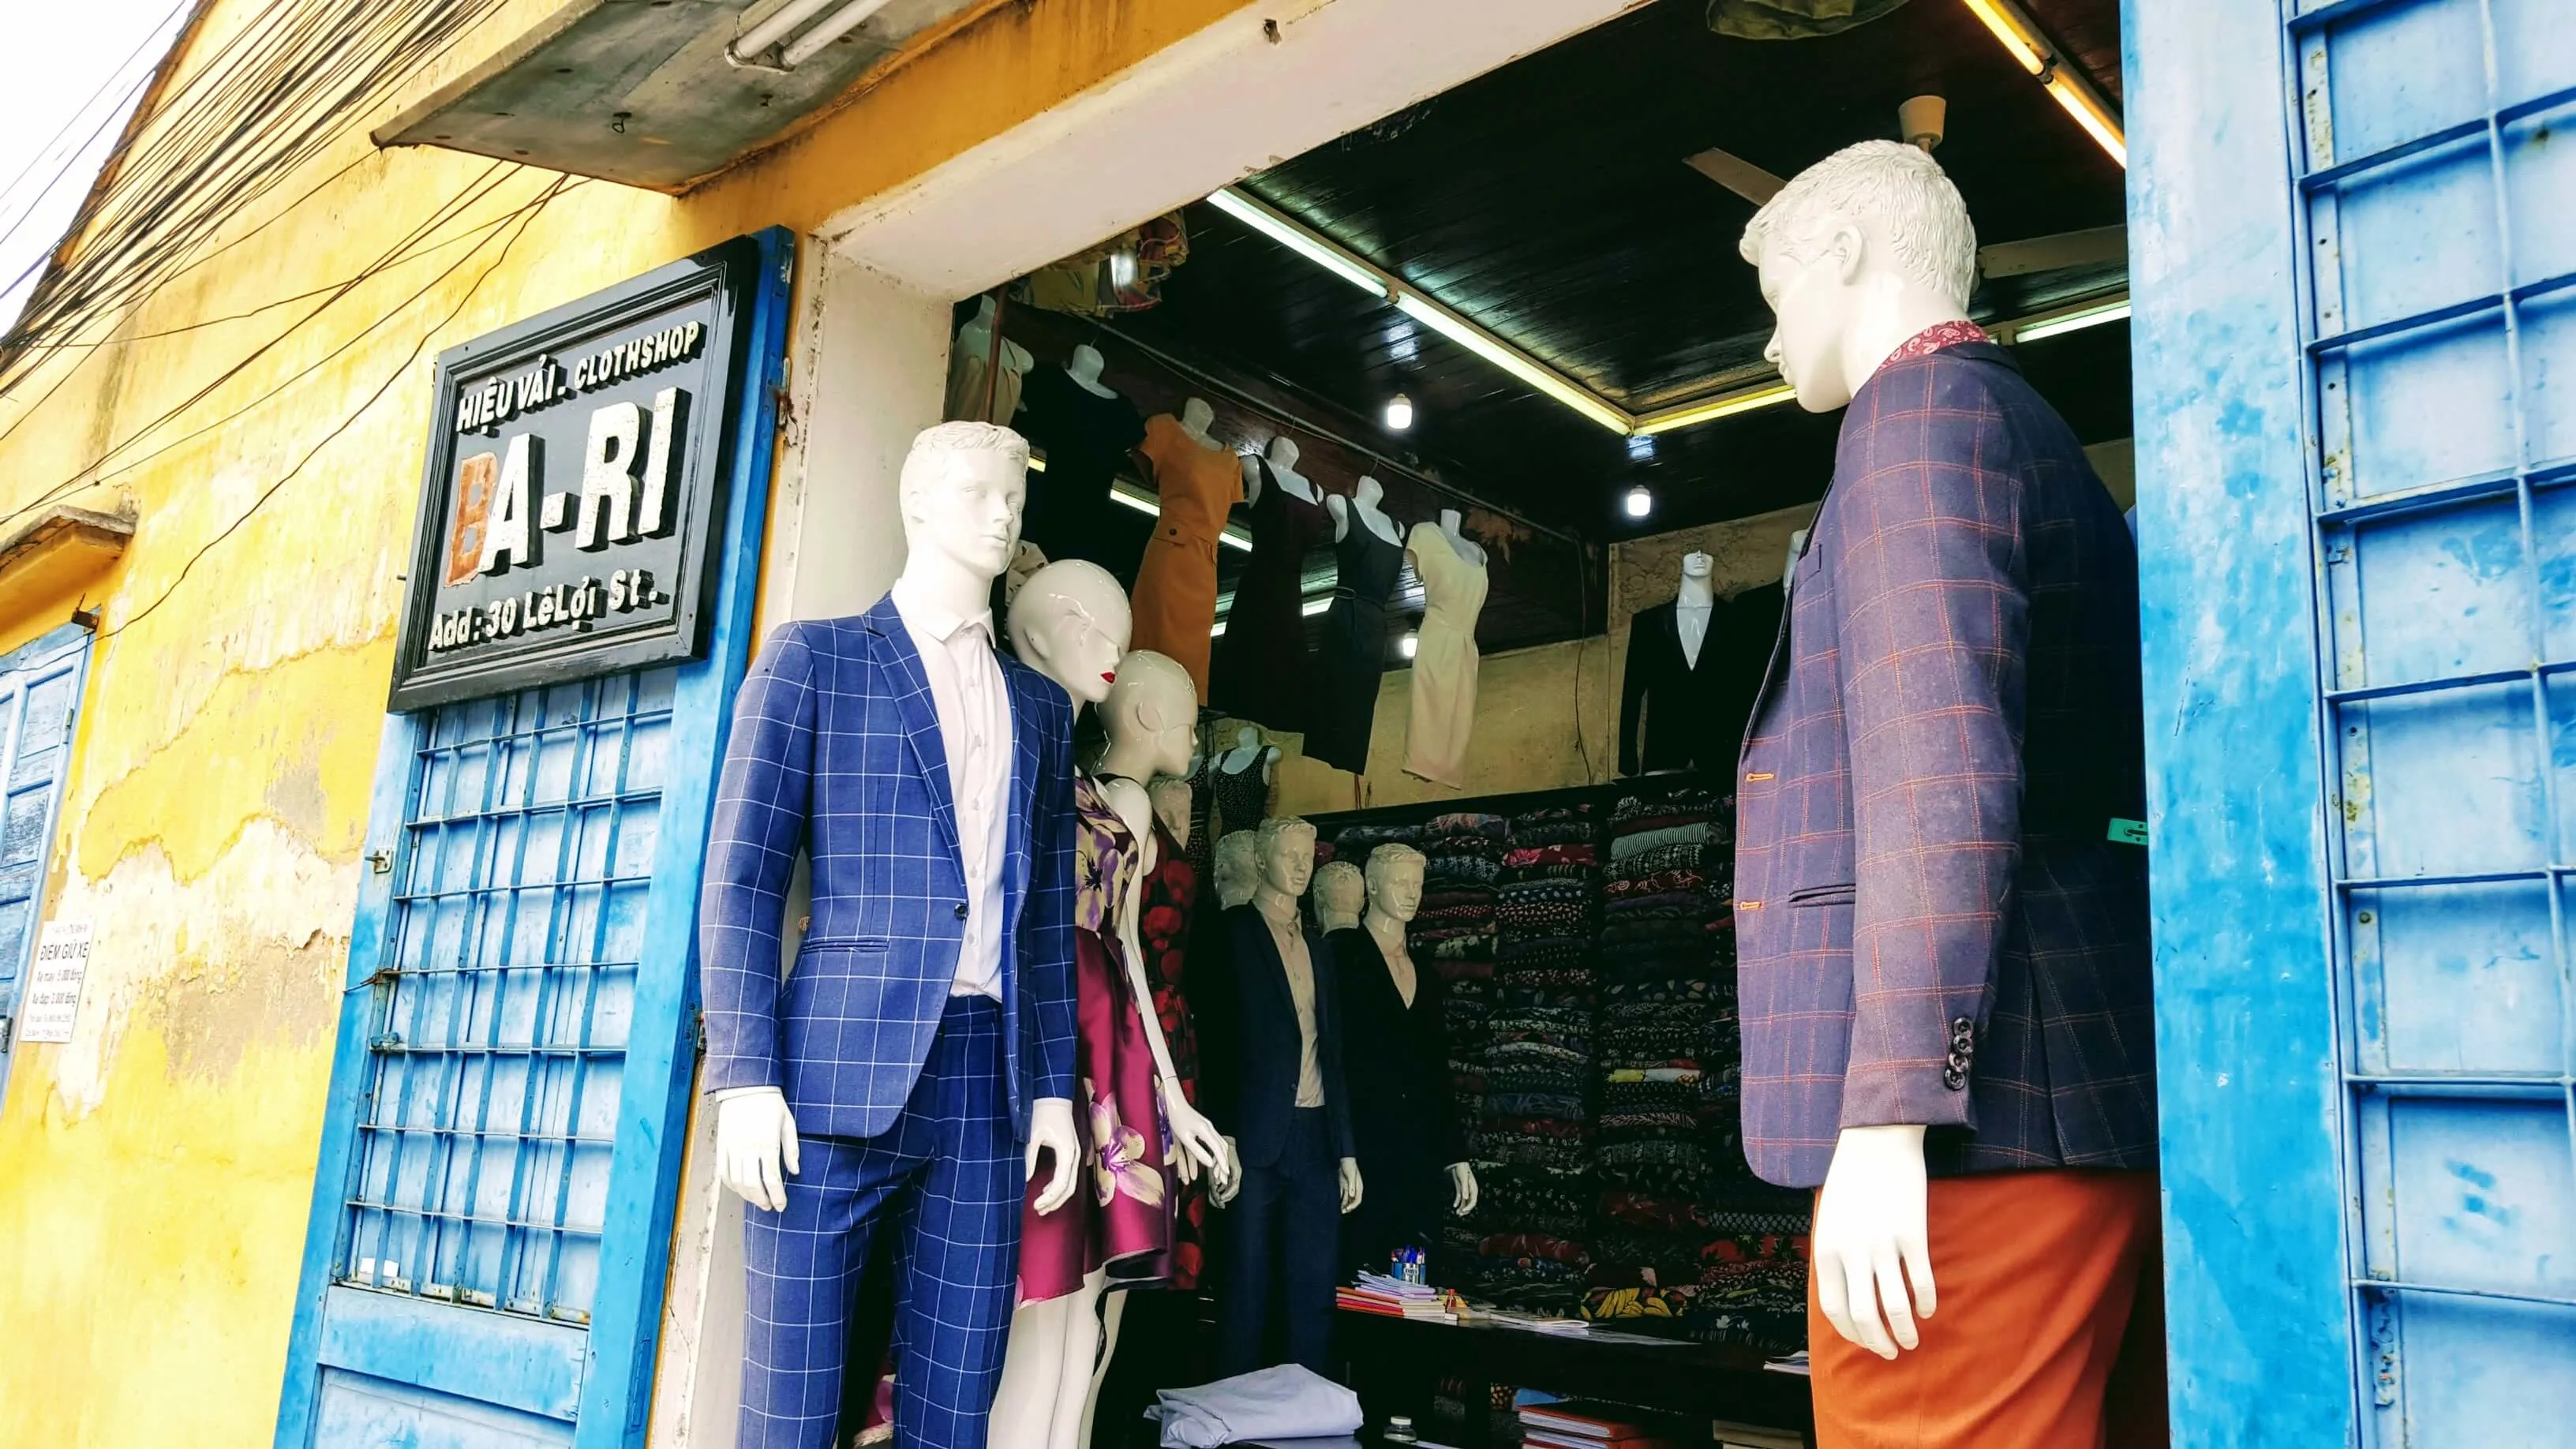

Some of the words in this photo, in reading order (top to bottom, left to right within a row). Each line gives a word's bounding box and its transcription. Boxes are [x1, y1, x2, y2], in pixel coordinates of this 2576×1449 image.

[455, 376, 512, 435] HIỆU
[574, 320, 700, 391] CLOTHSHOP
[485, 597, 518, 638] 30
